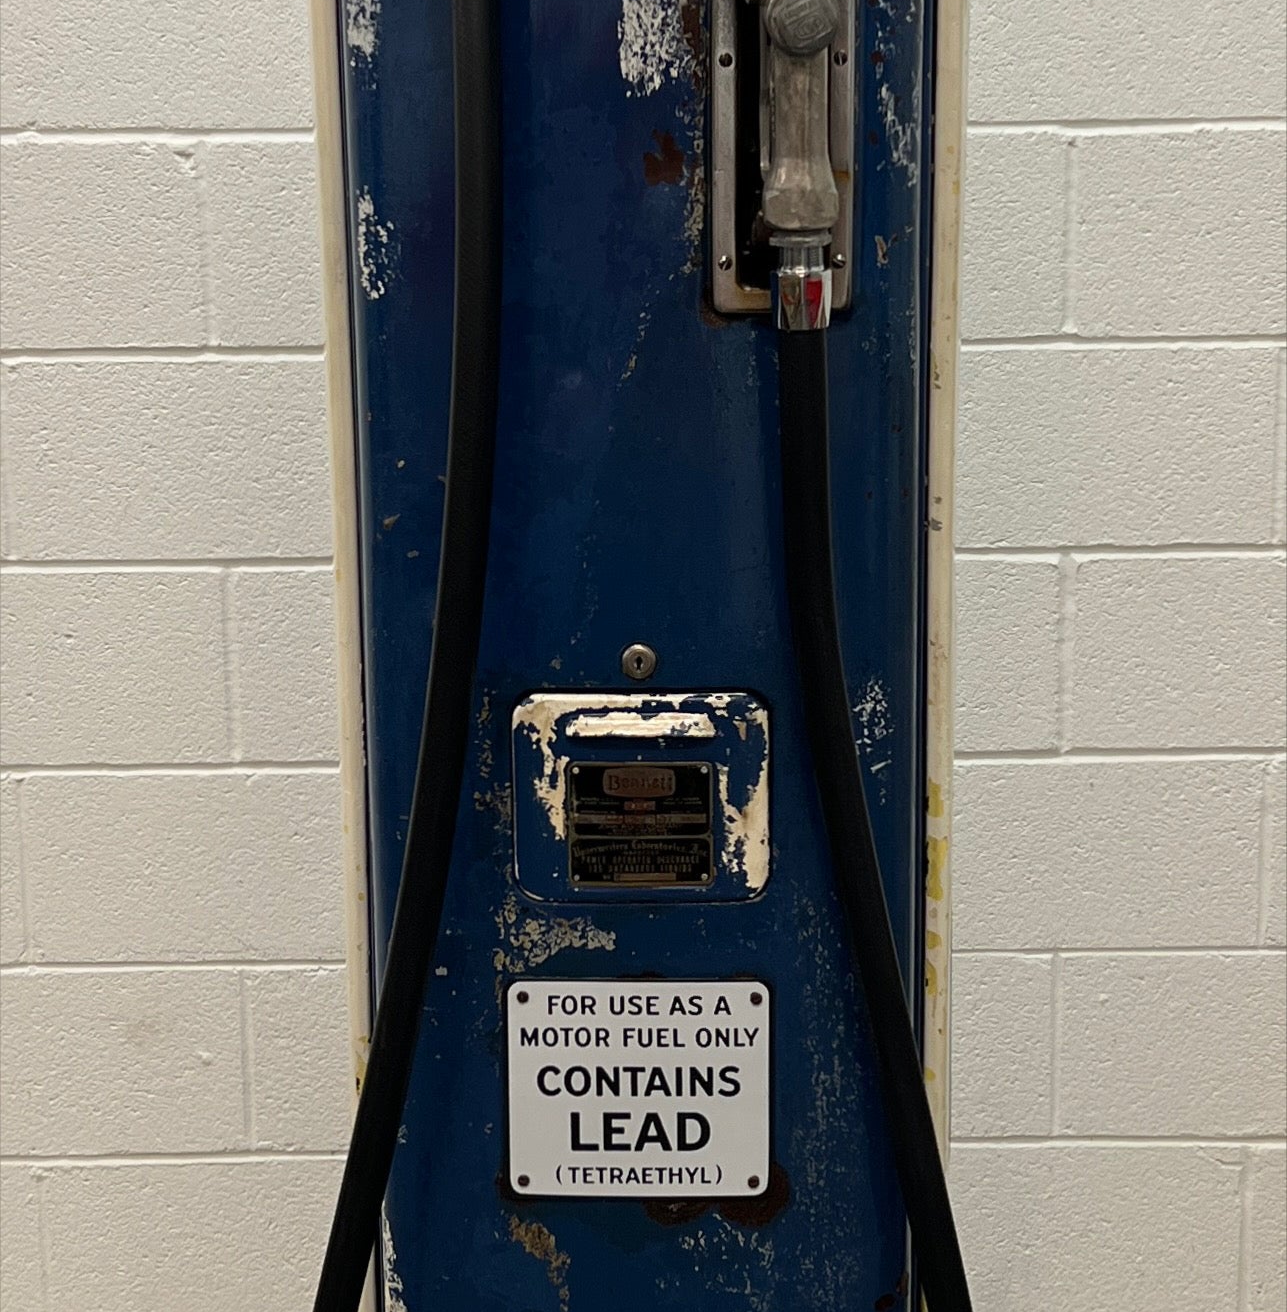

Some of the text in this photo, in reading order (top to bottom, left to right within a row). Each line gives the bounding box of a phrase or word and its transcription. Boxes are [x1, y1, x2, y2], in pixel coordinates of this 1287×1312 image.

[547, 995, 732, 1015] FOR USE AS A
[520, 1027, 759, 1048] MOTOR FUEL ONLY
[536, 1065, 741, 1097] CONTAINS
[569, 1111, 711, 1152] LEAD
[555, 1164, 723, 1186] (TETRAETHYL)
